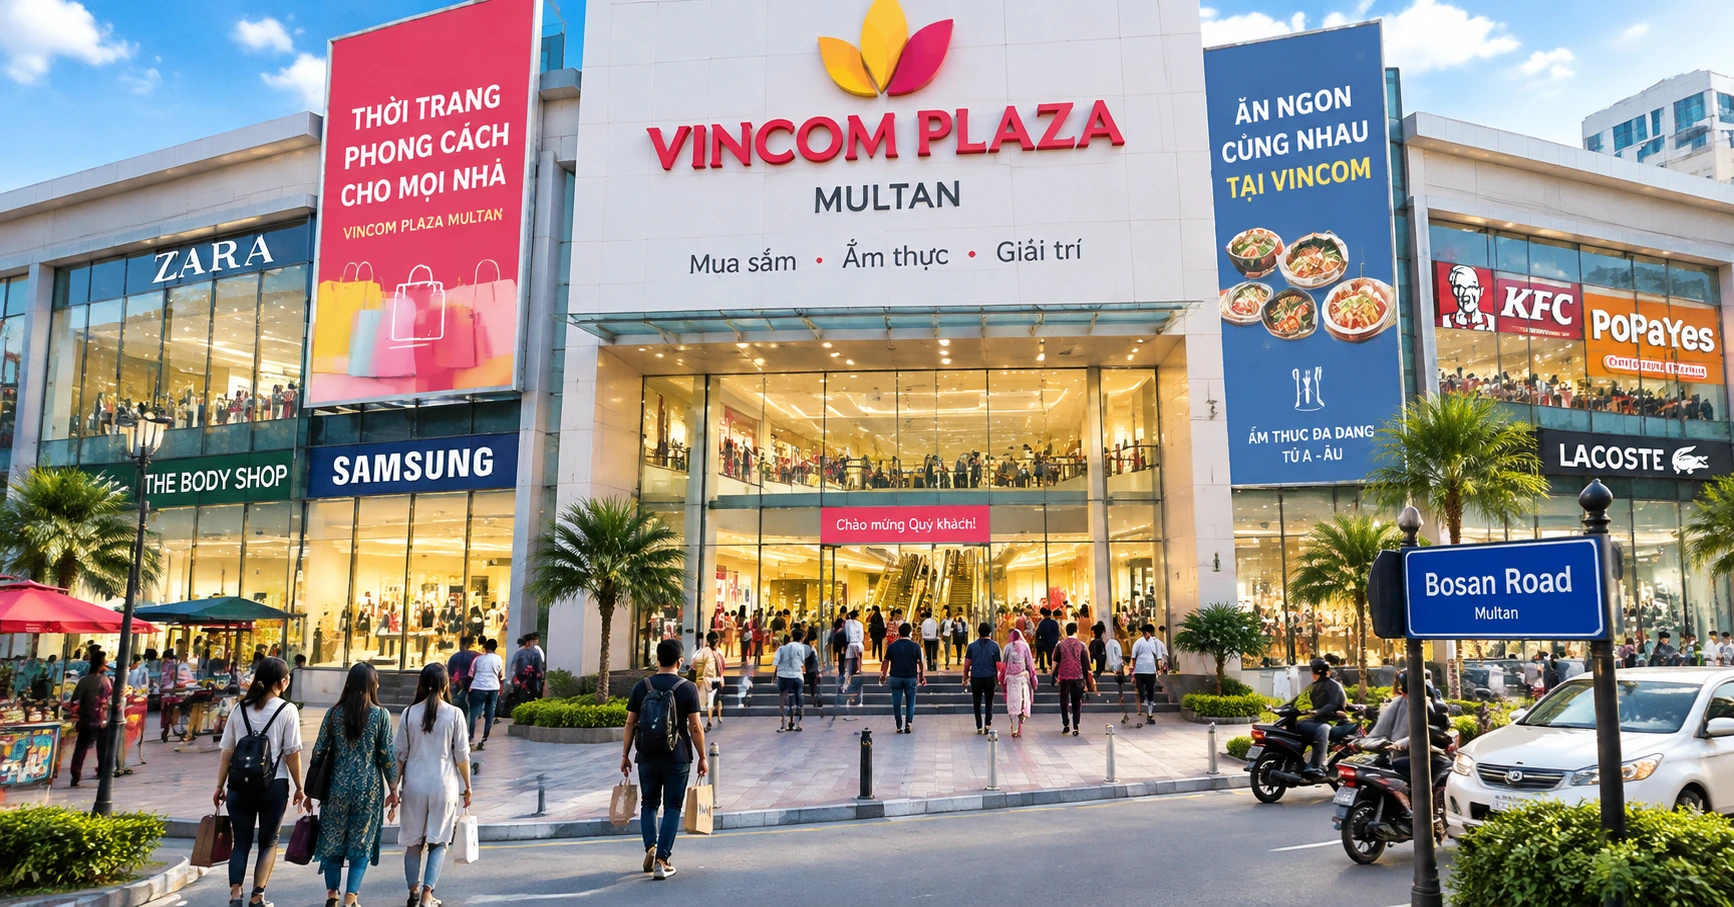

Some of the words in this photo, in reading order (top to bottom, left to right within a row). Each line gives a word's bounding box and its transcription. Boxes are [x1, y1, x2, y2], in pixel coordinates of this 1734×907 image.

[352, 96, 408, 131] THỜI
[416, 84, 500, 120] TRANG
[1235, 97, 1269, 125] ĂN
[1277, 85, 1352, 118] NGON
[344, 134, 433, 170] PHONG
[646, 112, 898, 171] VINCOM
[917, 99, 1126, 157] PLAZA
[1296, 120, 1369, 152] NHAU
[341, 179, 391, 207] CHO
[398, 171, 445, 203] MỌI
[814, 180, 961, 214] MULTAN
[1226, 173, 1265, 203] TẠI
[1271, 157, 1371, 192] VINCOM
[343, 221, 397, 239] VINCOM
[401, 215, 444, 232] PLAZA
[448, 208, 503, 226] MULTAN
[152, 234, 274, 284] ZARA
[689, 253, 740, 275] Mua
[748, 247, 797, 273] sắm
[893, 245, 949, 271] thực
[996, 239, 1045, 263] Giải
[1053, 238, 1082, 260] trí
[1501, 286, 1573, 326] KFC
[1272, 428, 1309, 443] THUC
[1313, 427, 1332, 440] ĐA
[1335, 424, 1375, 439] DANG
[332, 446, 495, 486] SAMSUNG
[1302, 448, 1313, 462] A
[1559, 443, 1665, 471] LACOSTE
[145, 472, 177, 494] THE
[180, 468, 232, 493] BODY
[235, 464, 288, 489] SHOP
[1425, 571, 1496, 597] Bosan
[1505, 565, 1573, 594] Road
[1474, 606, 1519, 620] Multan
